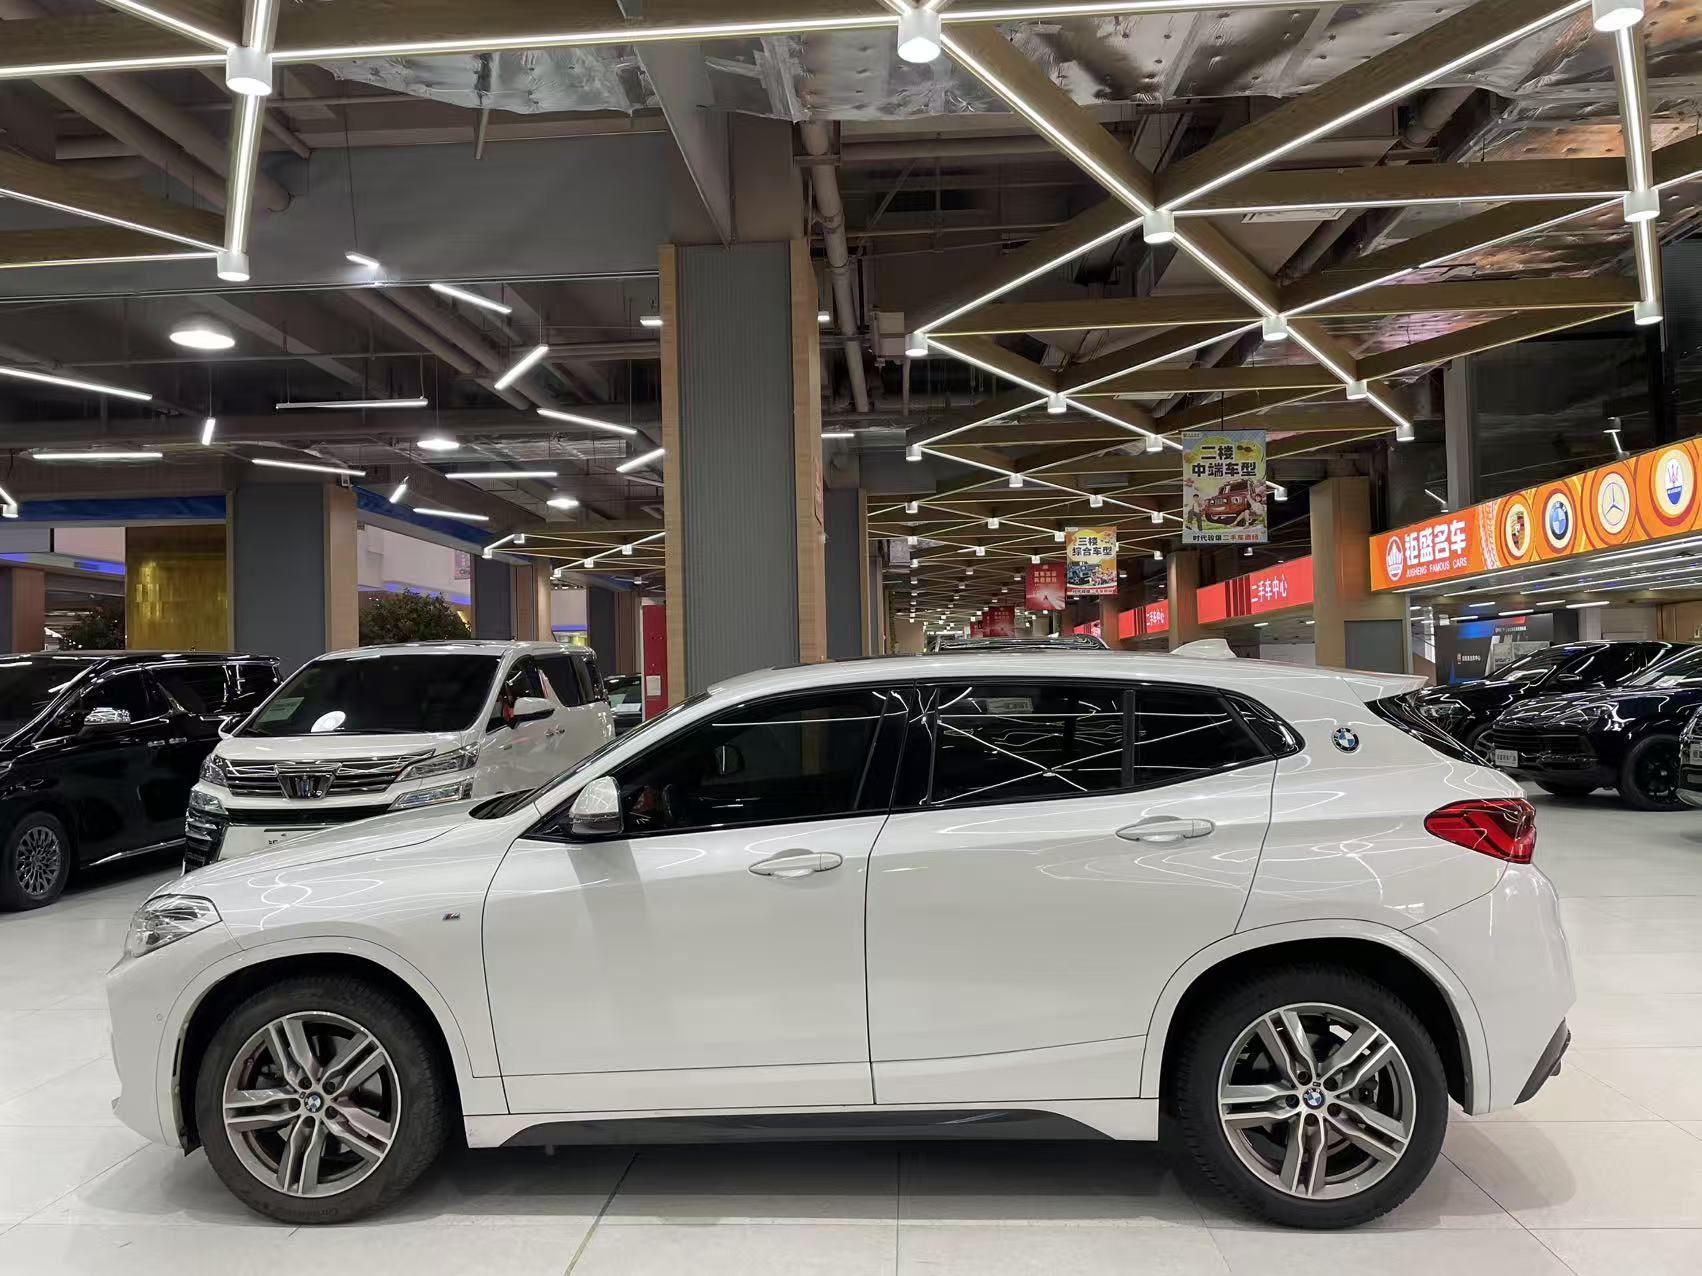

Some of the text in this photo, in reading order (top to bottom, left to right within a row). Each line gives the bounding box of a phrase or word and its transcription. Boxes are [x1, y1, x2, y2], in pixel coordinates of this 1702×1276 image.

[1201, 445, 1233, 460] 二楼
[1191, 462, 1256, 477] 中端车型
[1078, 537, 1097, 546] 三楼
[1072, 547, 1112, 556] 综合车型
[1406, 566, 1428, 577] JUSHENG
[1429, 561, 1450, 573] FAMOUS
[1453, 557, 1467, 568] CARS
[1251, 573, 1288, 602] 二手车中心
